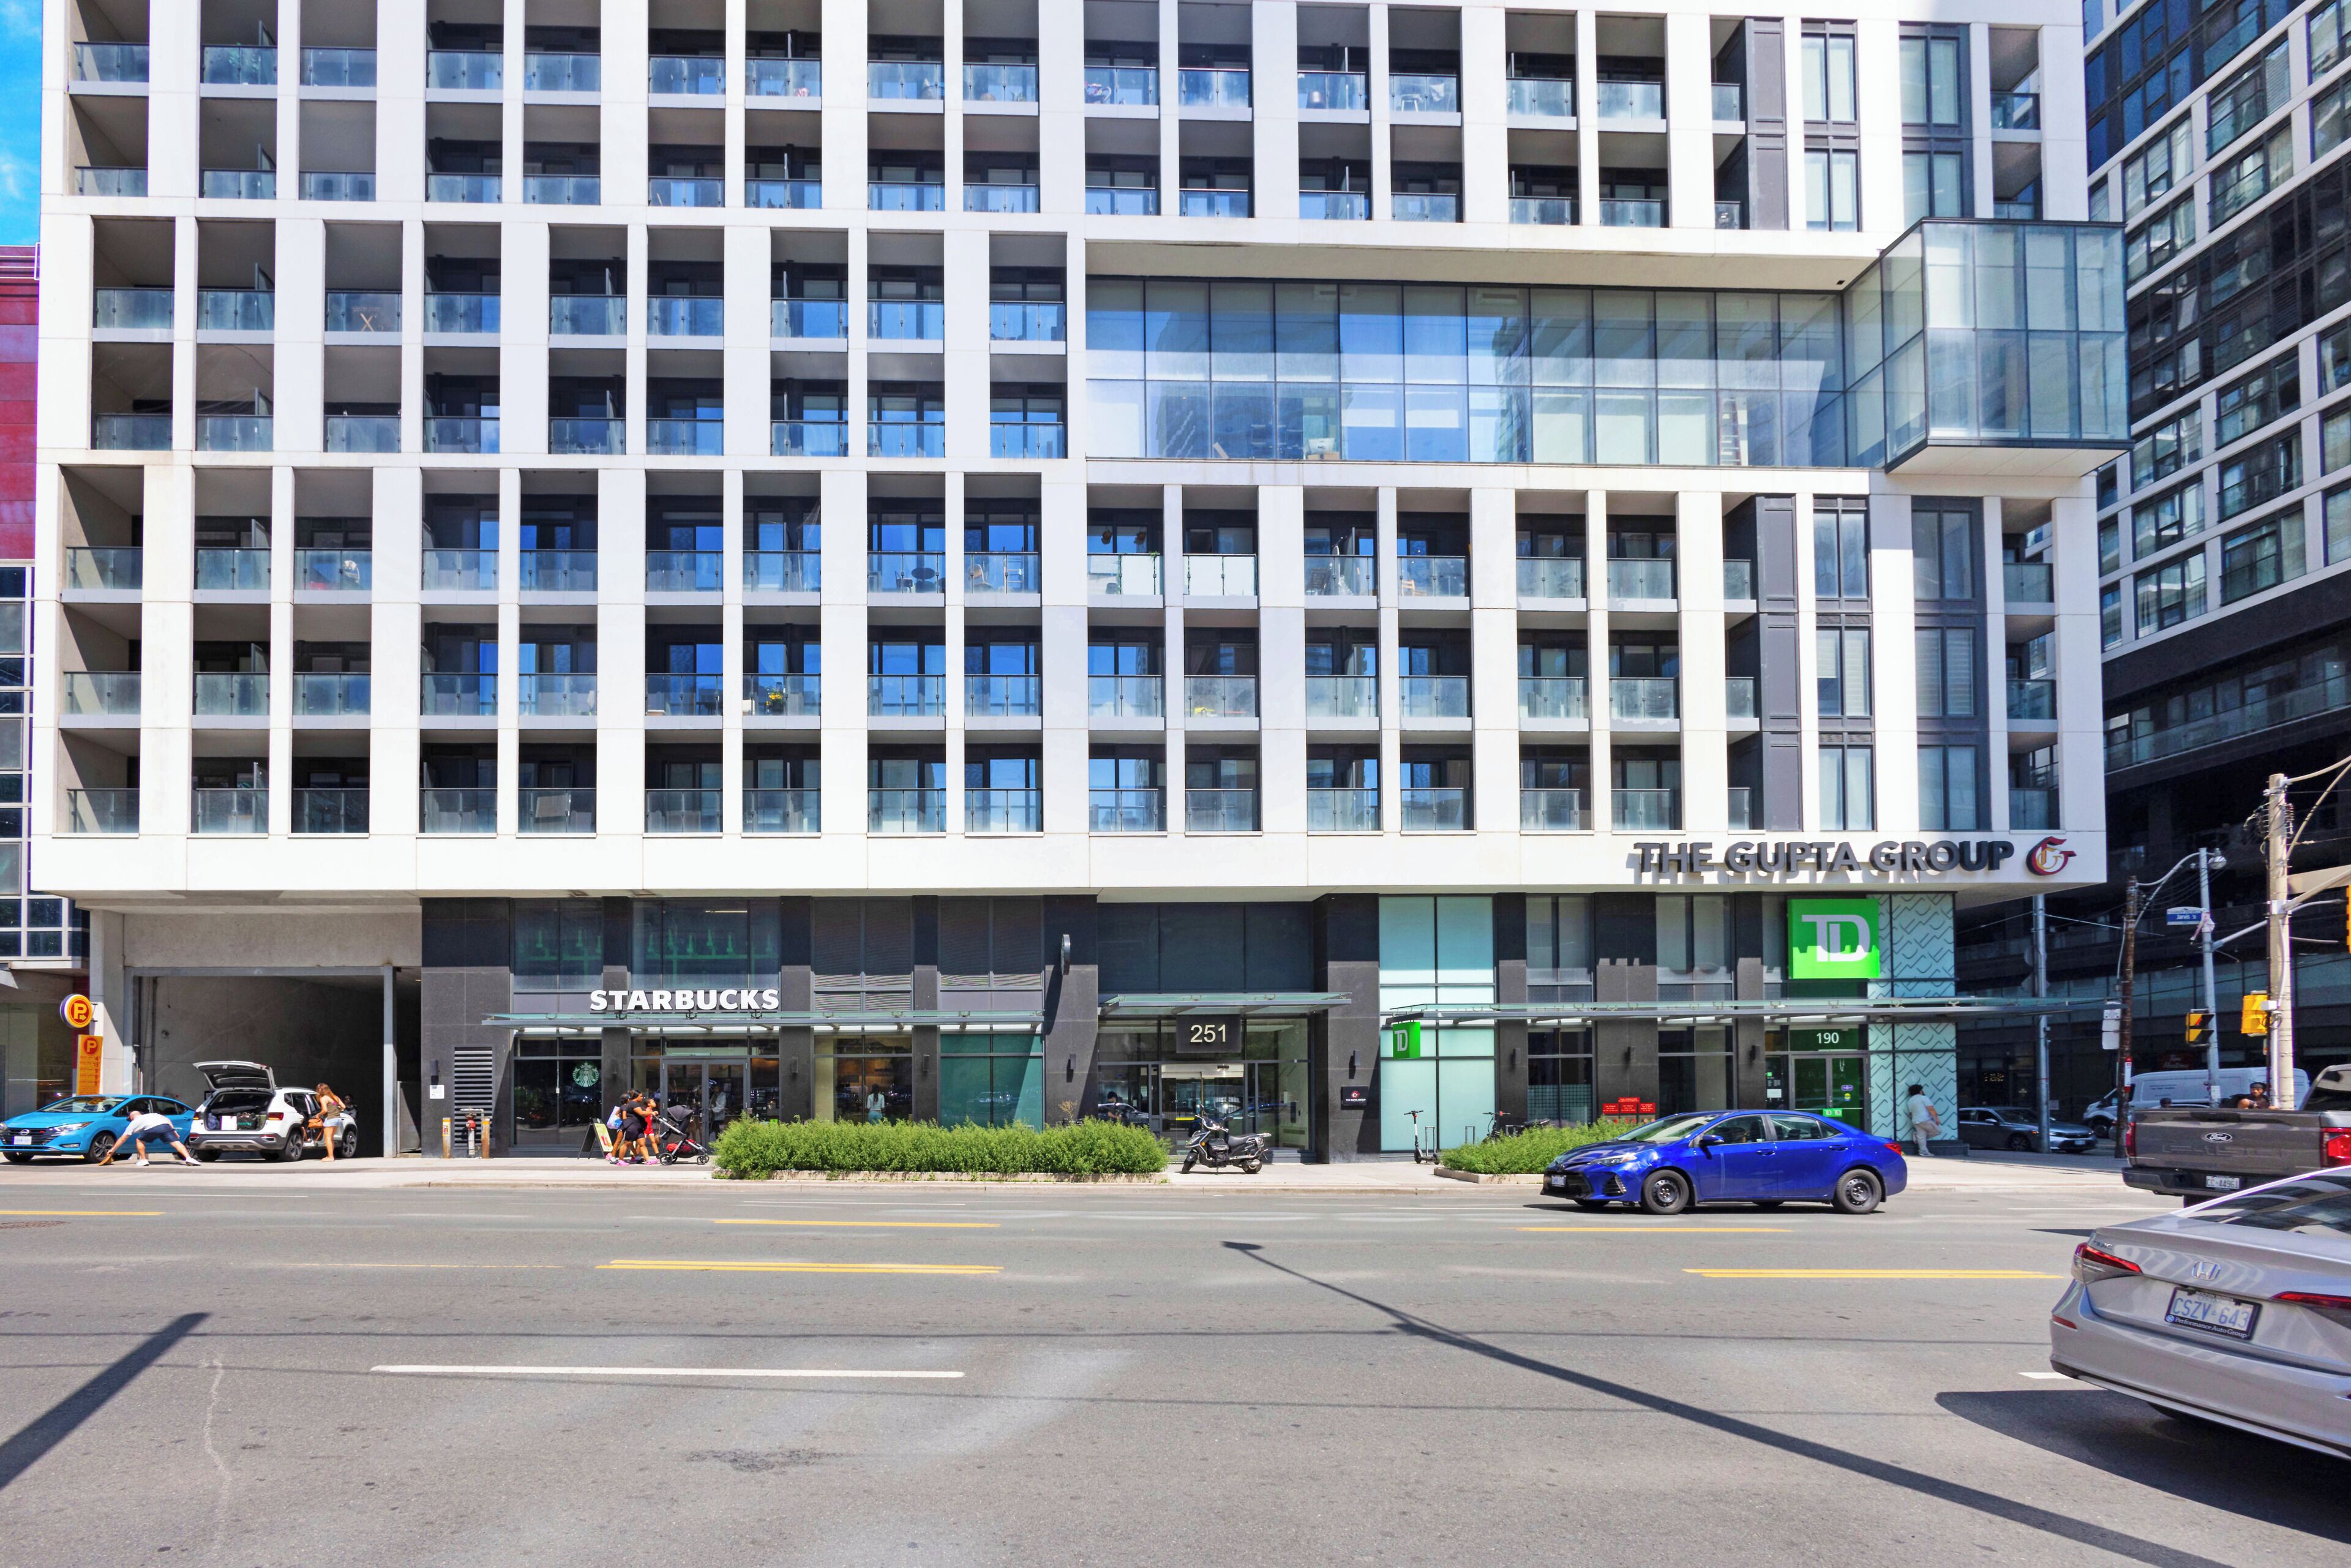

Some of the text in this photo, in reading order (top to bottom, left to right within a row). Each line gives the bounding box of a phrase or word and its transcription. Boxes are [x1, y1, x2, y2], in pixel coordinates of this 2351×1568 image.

[1633, 840, 2014, 873] THE GUPTA GROUP
[1802, 915, 1870, 962] TD
[590, 989, 779, 1010] STARBUCKS
[73, 1003, 87, 1019] P
[1190, 1024, 1226, 1043] 251
[1394, 1029, 1408, 1052] TD
[1817, 1032, 1839, 1044] 190
[86, 1040, 97, 1052] P
[2210, 1133, 2228, 1141] Ford
[2175, 1316, 2211, 1330] Performance
[2227, 1329, 2248, 1339] Group
